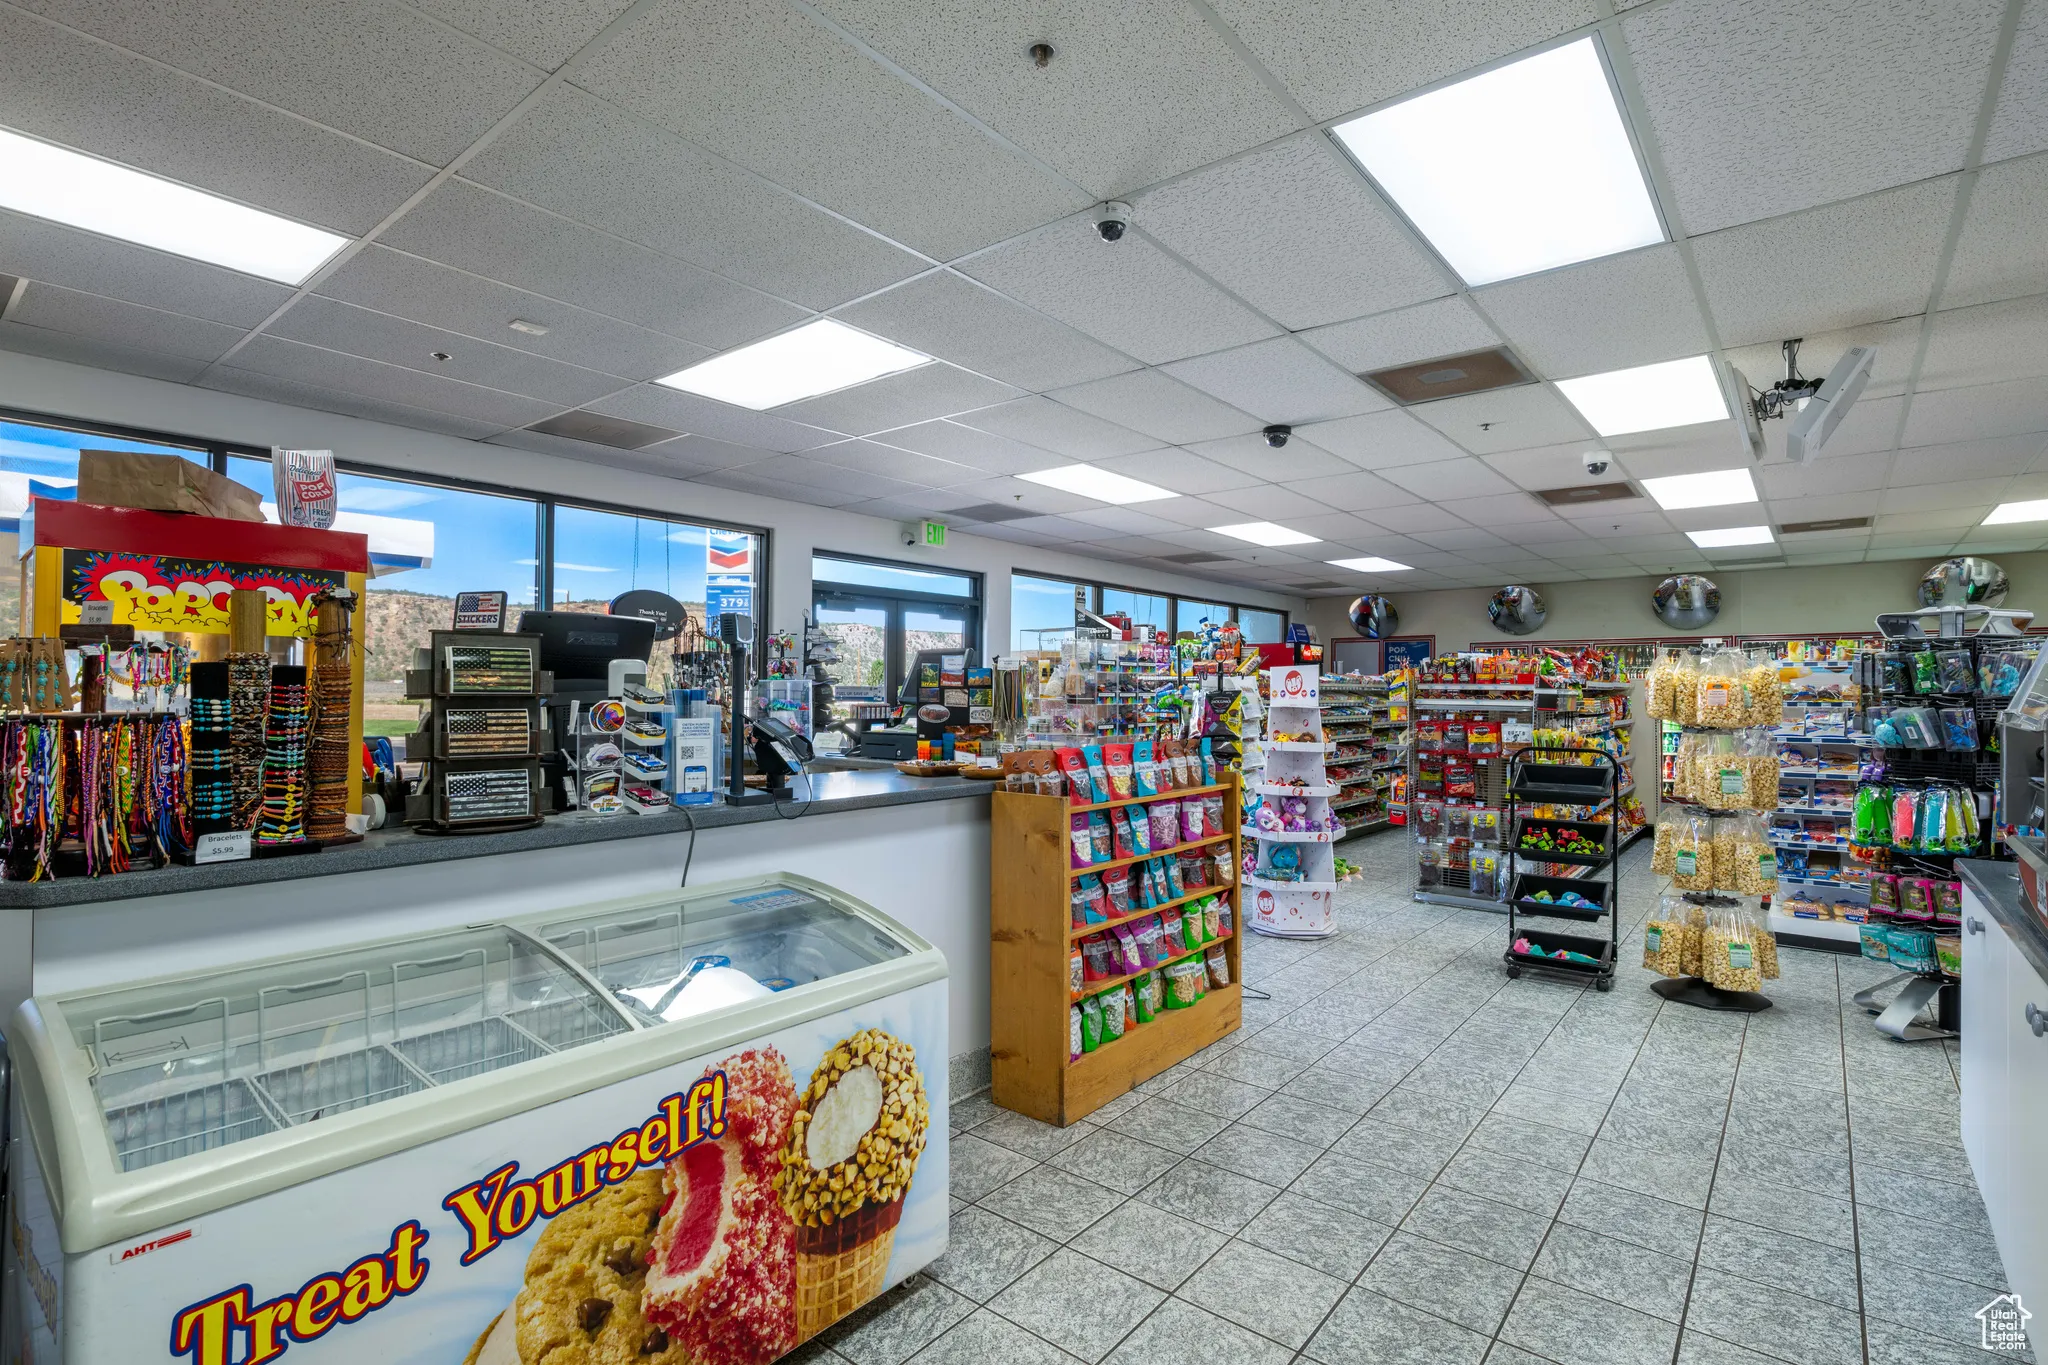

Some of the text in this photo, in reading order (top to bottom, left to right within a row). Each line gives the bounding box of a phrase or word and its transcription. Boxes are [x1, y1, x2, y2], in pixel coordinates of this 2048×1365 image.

[300, 482, 325, 491] POP
[301, 488, 331, 499] CORN
[312, 508, 331, 517] FRESH
[927, 522, 945, 546] EXIT
[99, 569, 320, 628] POPCRN
[87, 604, 109, 612] Bracelets
[457, 614, 498, 624] STICKERS
[1388, 646, 1408, 654] POP.
[207, 834, 243, 843] Bracelets
[212, 846, 234, 855] $5.99
[1257, 912, 1275, 924] Fiesta
[170, 1219, 430, 1365] Treat
[443, 1070, 728, 1267] Yourself!
[121, 1241, 157, 1260] AHT
